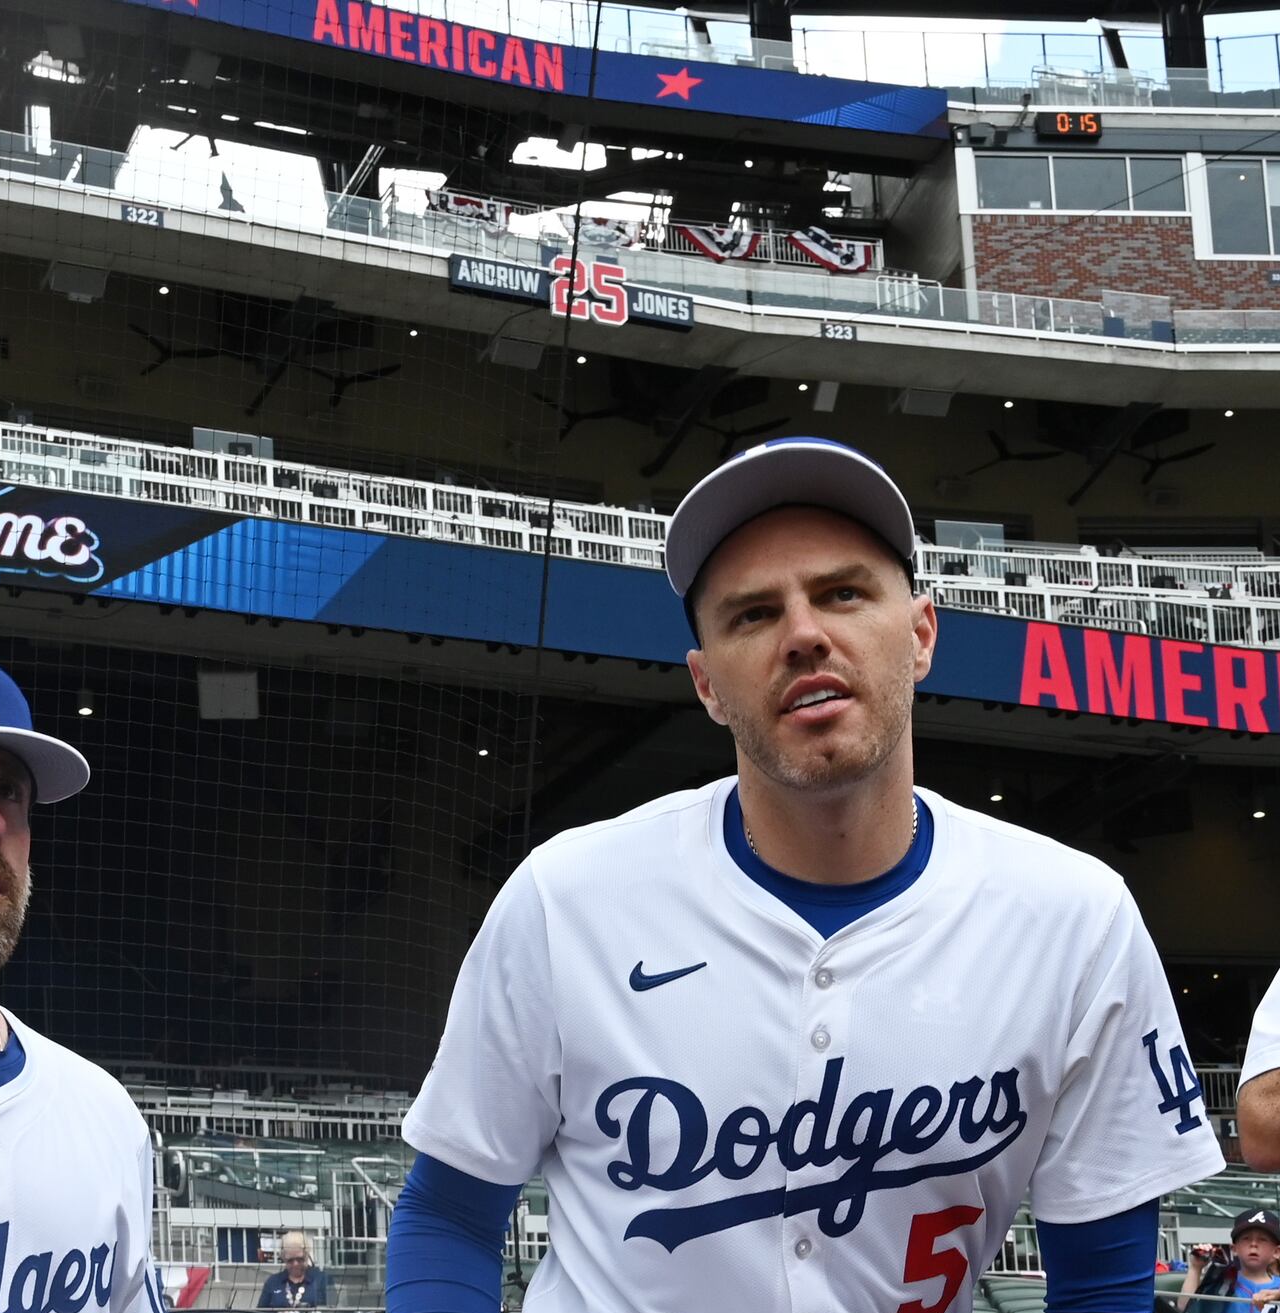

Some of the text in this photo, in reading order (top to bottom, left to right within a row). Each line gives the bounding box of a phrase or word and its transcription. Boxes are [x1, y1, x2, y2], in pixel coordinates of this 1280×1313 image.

[313, 0, 564, 91] AMERICAN
[1056, 113, 1098, 133] 0:15
[127, 206, 159, 226] 322
[457, 254, 691, 327] ANDRUW 25 JONES
[825, 324, 853, 340] 323
[1142, 1028, 1211, 1136] LA
[595, 1056, 1027, 1253] Dodgers
